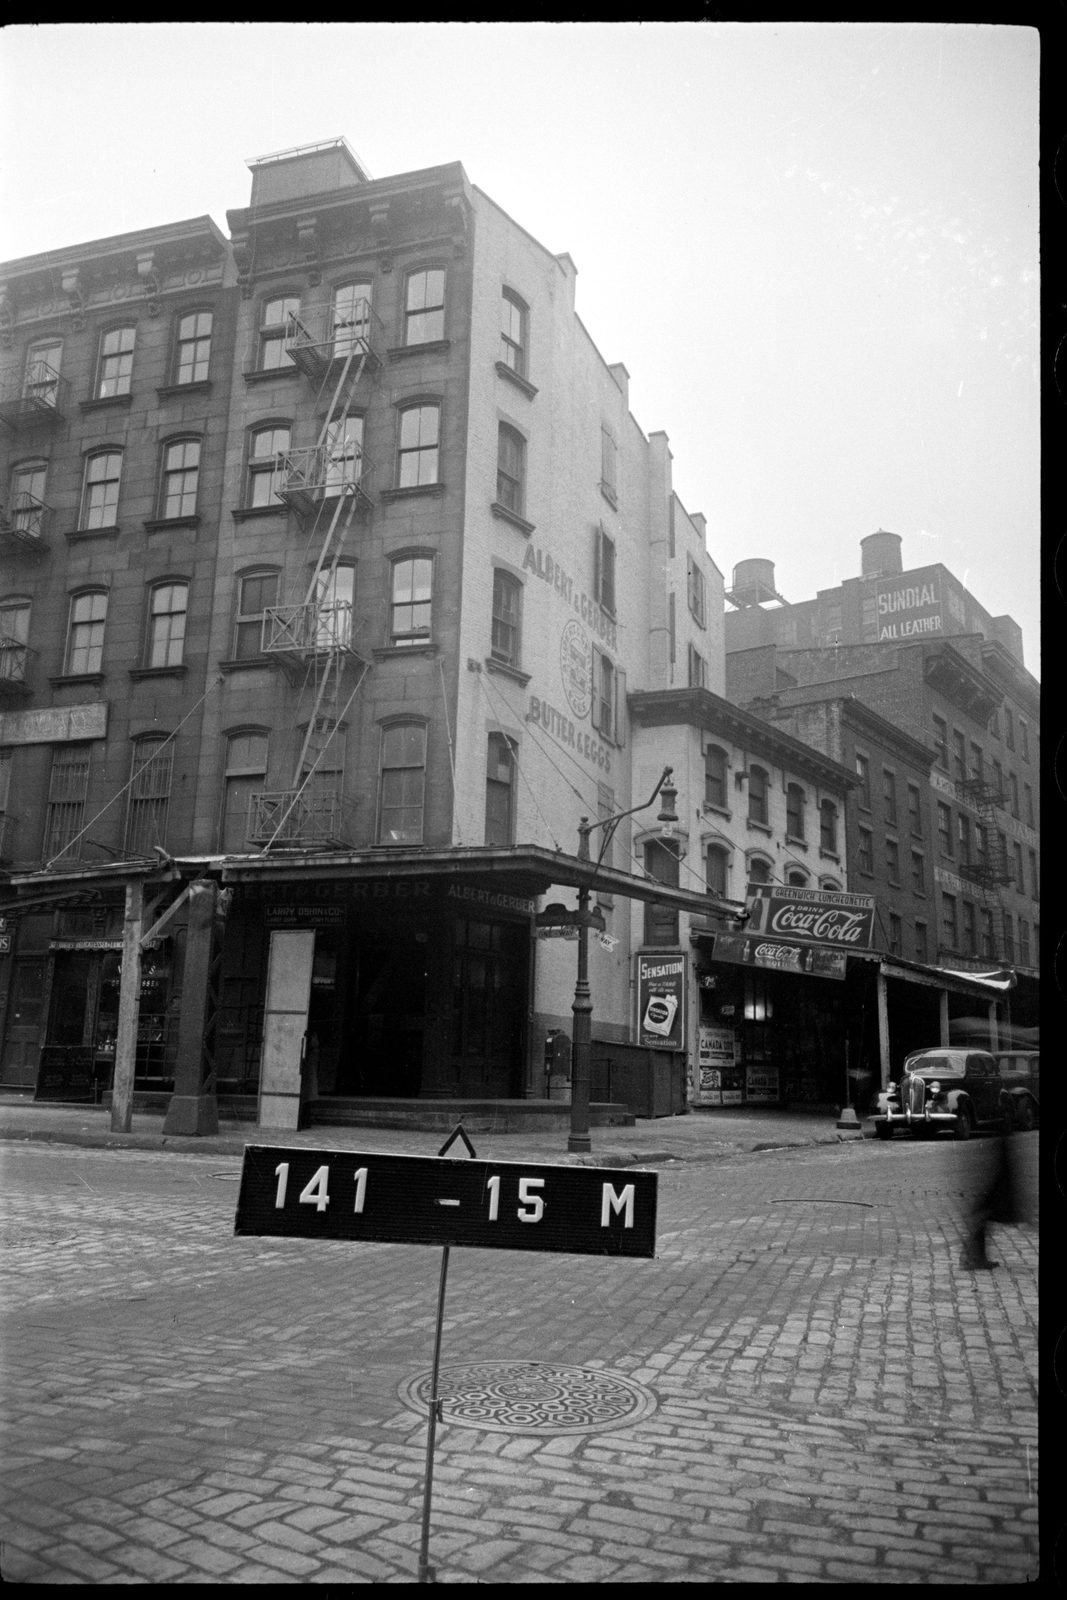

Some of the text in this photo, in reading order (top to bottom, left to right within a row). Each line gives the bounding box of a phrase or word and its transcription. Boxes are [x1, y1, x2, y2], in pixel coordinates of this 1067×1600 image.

[522, 544, 573, 605] ALBERT
[581, 592, 617, 651] GERBER
[878, 583, 940, 615] SUNDIAL
[880, 615, 942, 641] ALL LEATHER
[529, 695, 575, 749] BUTTER
[583, 734, 611, 774] EGGS
[313, 881, 433, 899] GERBER
[448, 884, 490, 904] ALBERT
[497, 893, 535, 913] GERBER
[774, 888, 871, 907] GREENWICH LUNCHEONETTE
[796, 905, 824, 913] DRINK
[771, 904, 868, 942] Coca-Cola
[641, 961, 683, 980] SENSATION
[700, 1039, 723, 1050] CANADA
[274, 1162, 369, 1214] 141
[487, 1175, 546, 1224] 15
[600, 1182, 636, 1229] M
